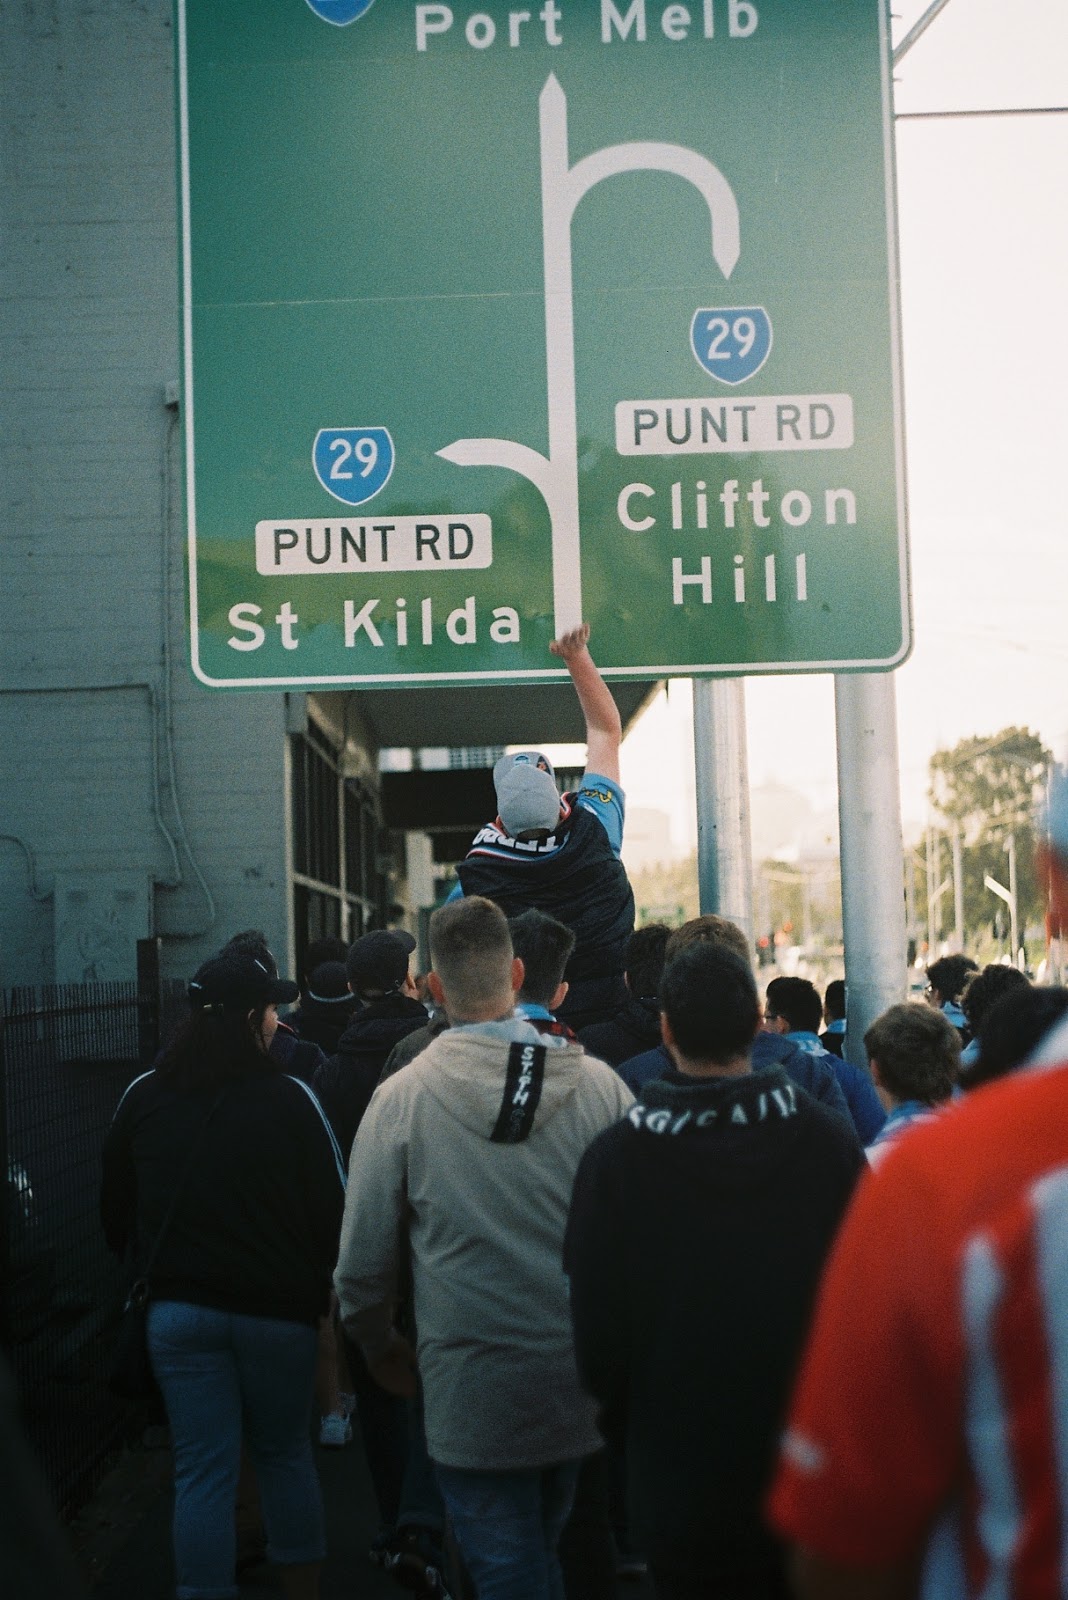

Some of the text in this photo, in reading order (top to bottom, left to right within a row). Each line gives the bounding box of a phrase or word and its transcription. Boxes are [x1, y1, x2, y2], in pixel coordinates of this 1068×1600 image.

[415, 0, 759, 51] Port Melb
[706, 316, 756, 360] 29
[633, 403, 836, 446] PUNT RD
[329, 437, 378, 480] 29
[616, 479, 857, 532] Clifton
[273, 523, 474, 566] PUNT RD
[672, 553, 808, 605] Hill
[227, 596, 520, 652] St Kilda
